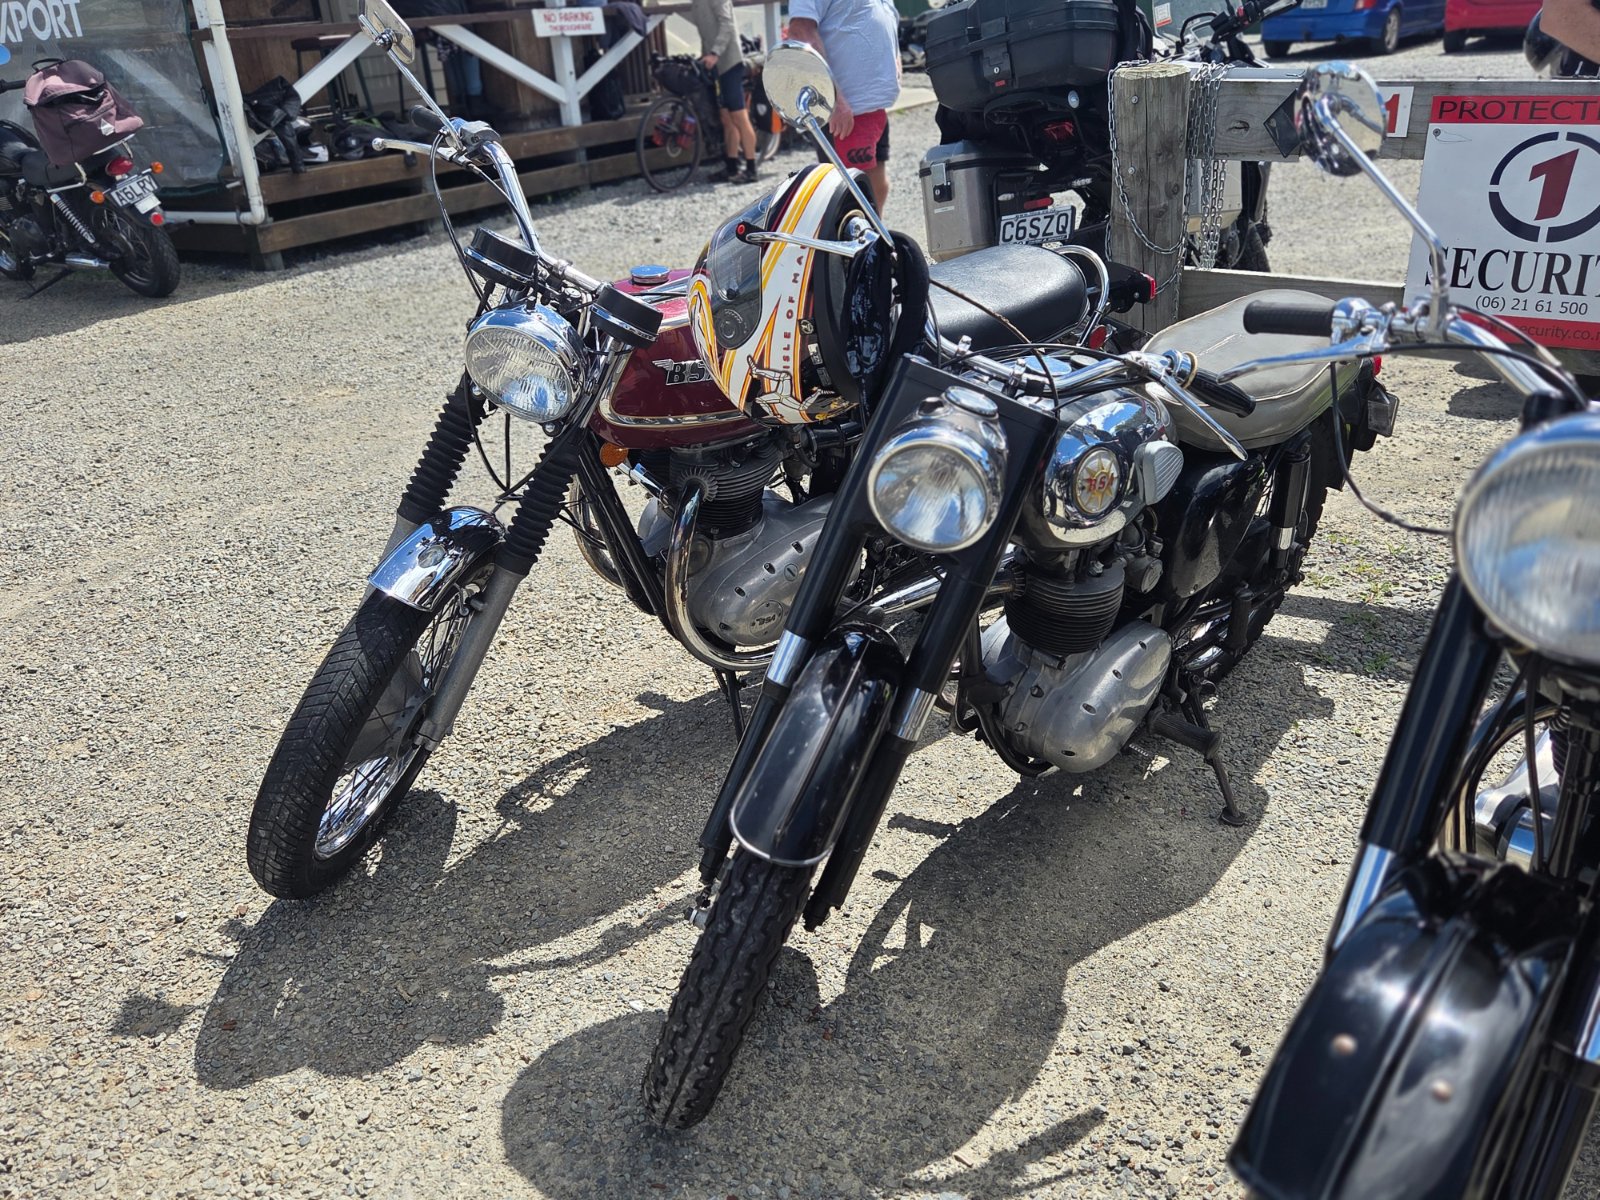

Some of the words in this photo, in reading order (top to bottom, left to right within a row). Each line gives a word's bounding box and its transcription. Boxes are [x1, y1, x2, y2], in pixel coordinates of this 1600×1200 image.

[543, 12, 557, 22] NO
[559, 11, 594, 21] PARKING
[1437, 100, 1600, 120] PROTECT
[115, 175, 158, 207] A6LRY
[1528, 148, 1579, 221] 1
[1001, 212, 1069, 243] C6SZQ
[792, 243, 807, 283] MA
[786, 296, 796, 319] OF
[1475, 295, 1506, 312] (06)
[1511, 297, 1528, 311] 21
[1534, 300, 1553, 313] 61
[1559, 301, 1588, 315] 500
[783, 331, 792, 369] ISLE
[666, 360, 711, 385] BS
[1087, 473, 1116, 492] BSA
[756, 614, 776, 626] BSA
